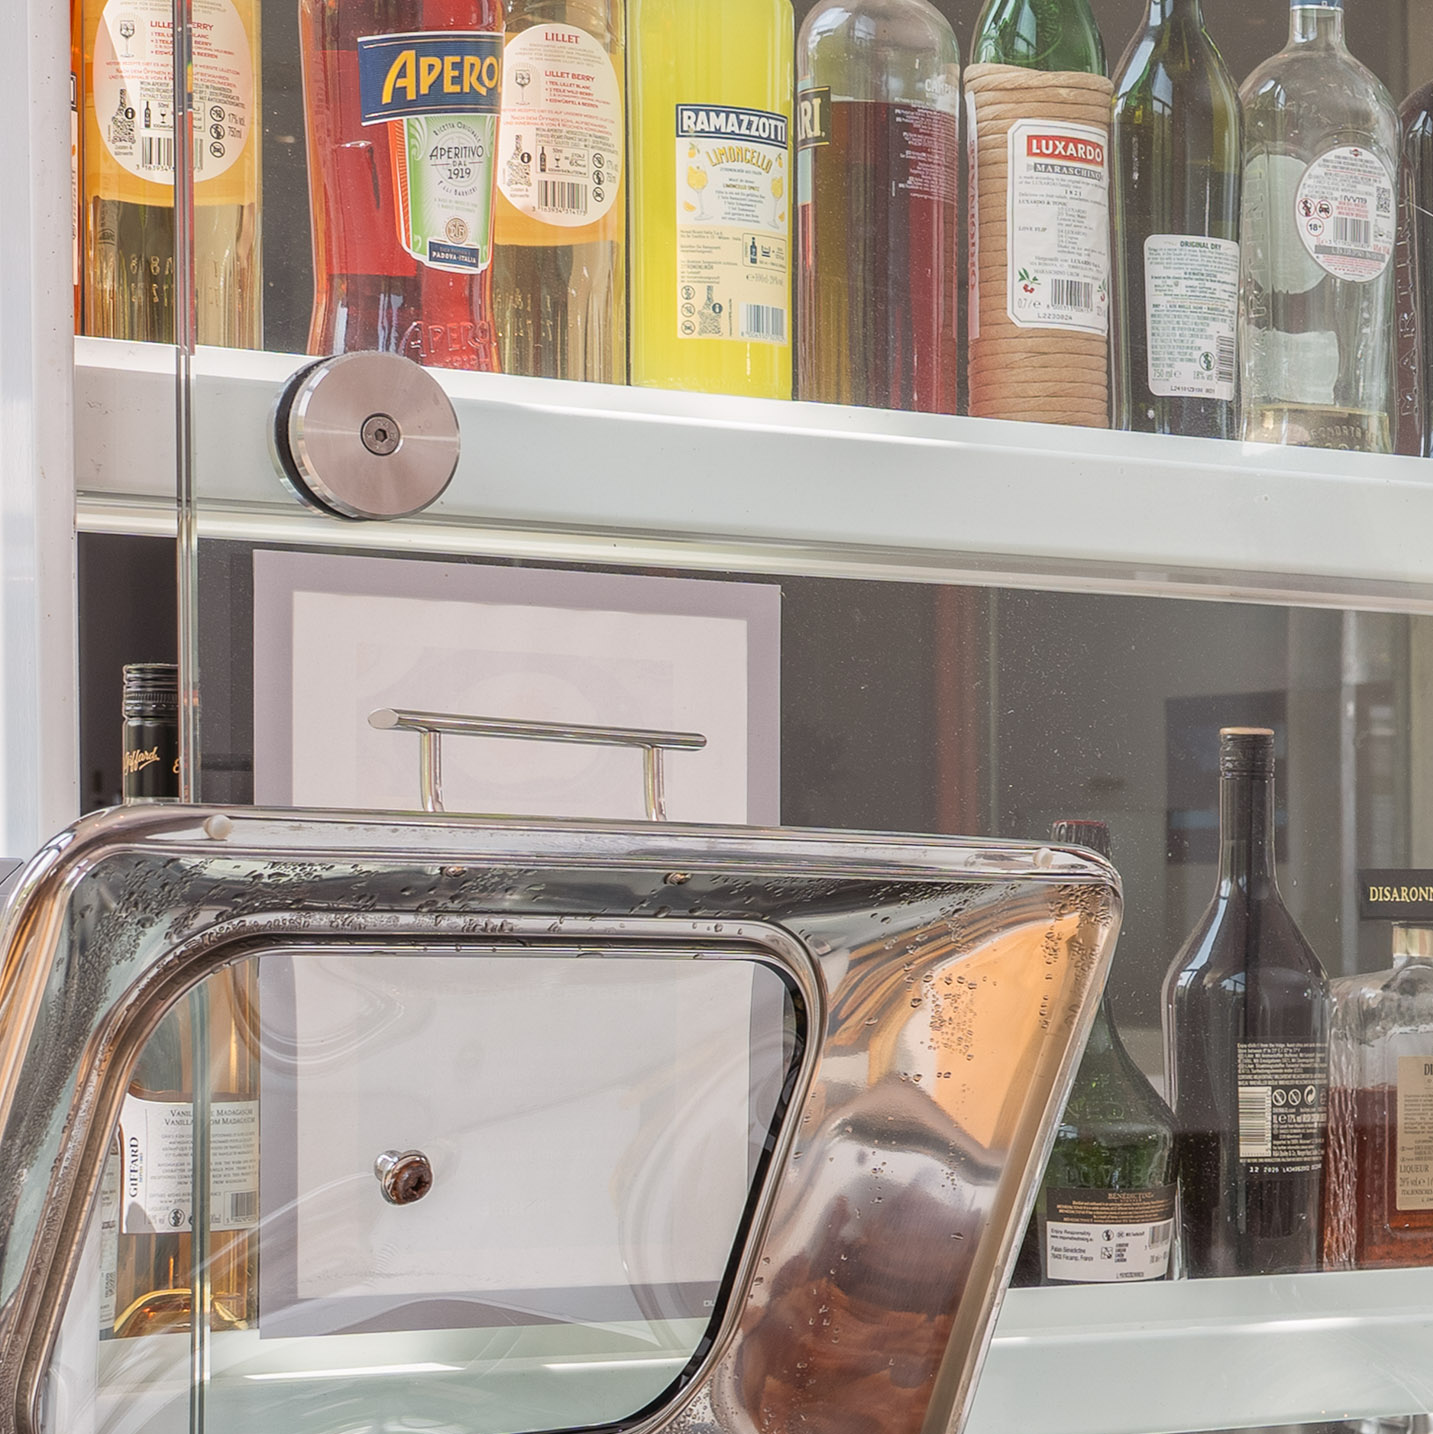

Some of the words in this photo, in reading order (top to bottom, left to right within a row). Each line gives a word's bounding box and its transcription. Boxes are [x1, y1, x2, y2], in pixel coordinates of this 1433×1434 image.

[150, 20, 173, 28] LILLE
[192, 22, 214, 31] ERRY
[544, 32, 580, 44] LILLET
[544, 70, 569, 79] LILLET
[571, 72, 595, 82] BERRY
[433, 122, 455, 137] RICETTA
[456, 121, 482, 143] ORIGINALE
[682, 110, 786, 142] RAMAZZOTTI
[429, 145, 484, 161] APERITIVO
[1032, 139, 1103, 162] LUXARDO
[705, 146, 774, 174] LIMONCELLO
[447, 168, 471, 180] 1919
[1035, 164, 1101, 182] MARASCHINO
[1179, 240, 1209, 250] ORIGINAL
[399, 320, 490, 358] APERO
[170, 1108, 193, 1117] VANIL
[128, 1136, 140, 1198] GIFFARD
[1400, 1164, 1430, 1174] LIQUEUR
